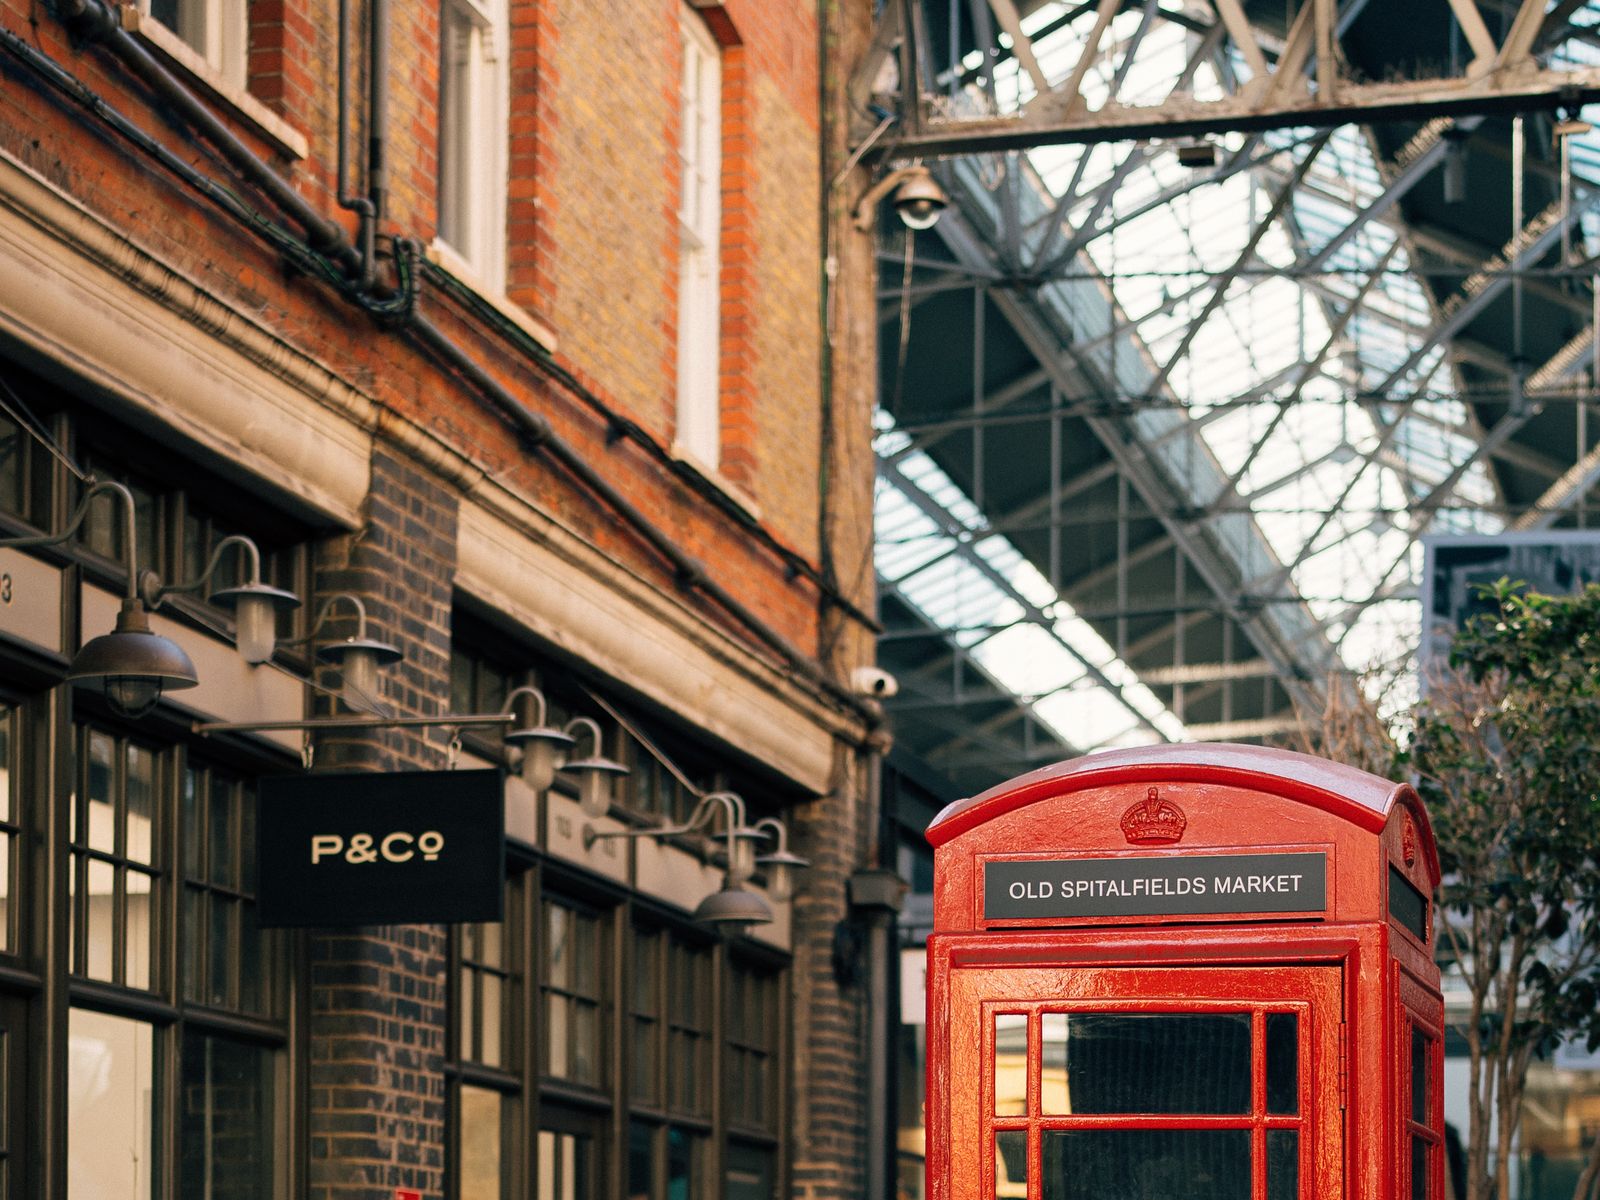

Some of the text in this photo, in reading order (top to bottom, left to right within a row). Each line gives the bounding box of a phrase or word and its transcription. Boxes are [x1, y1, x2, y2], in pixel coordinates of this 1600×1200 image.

[1009, 874, 1303, 899] OLD SPITALFIELDS MARKET
